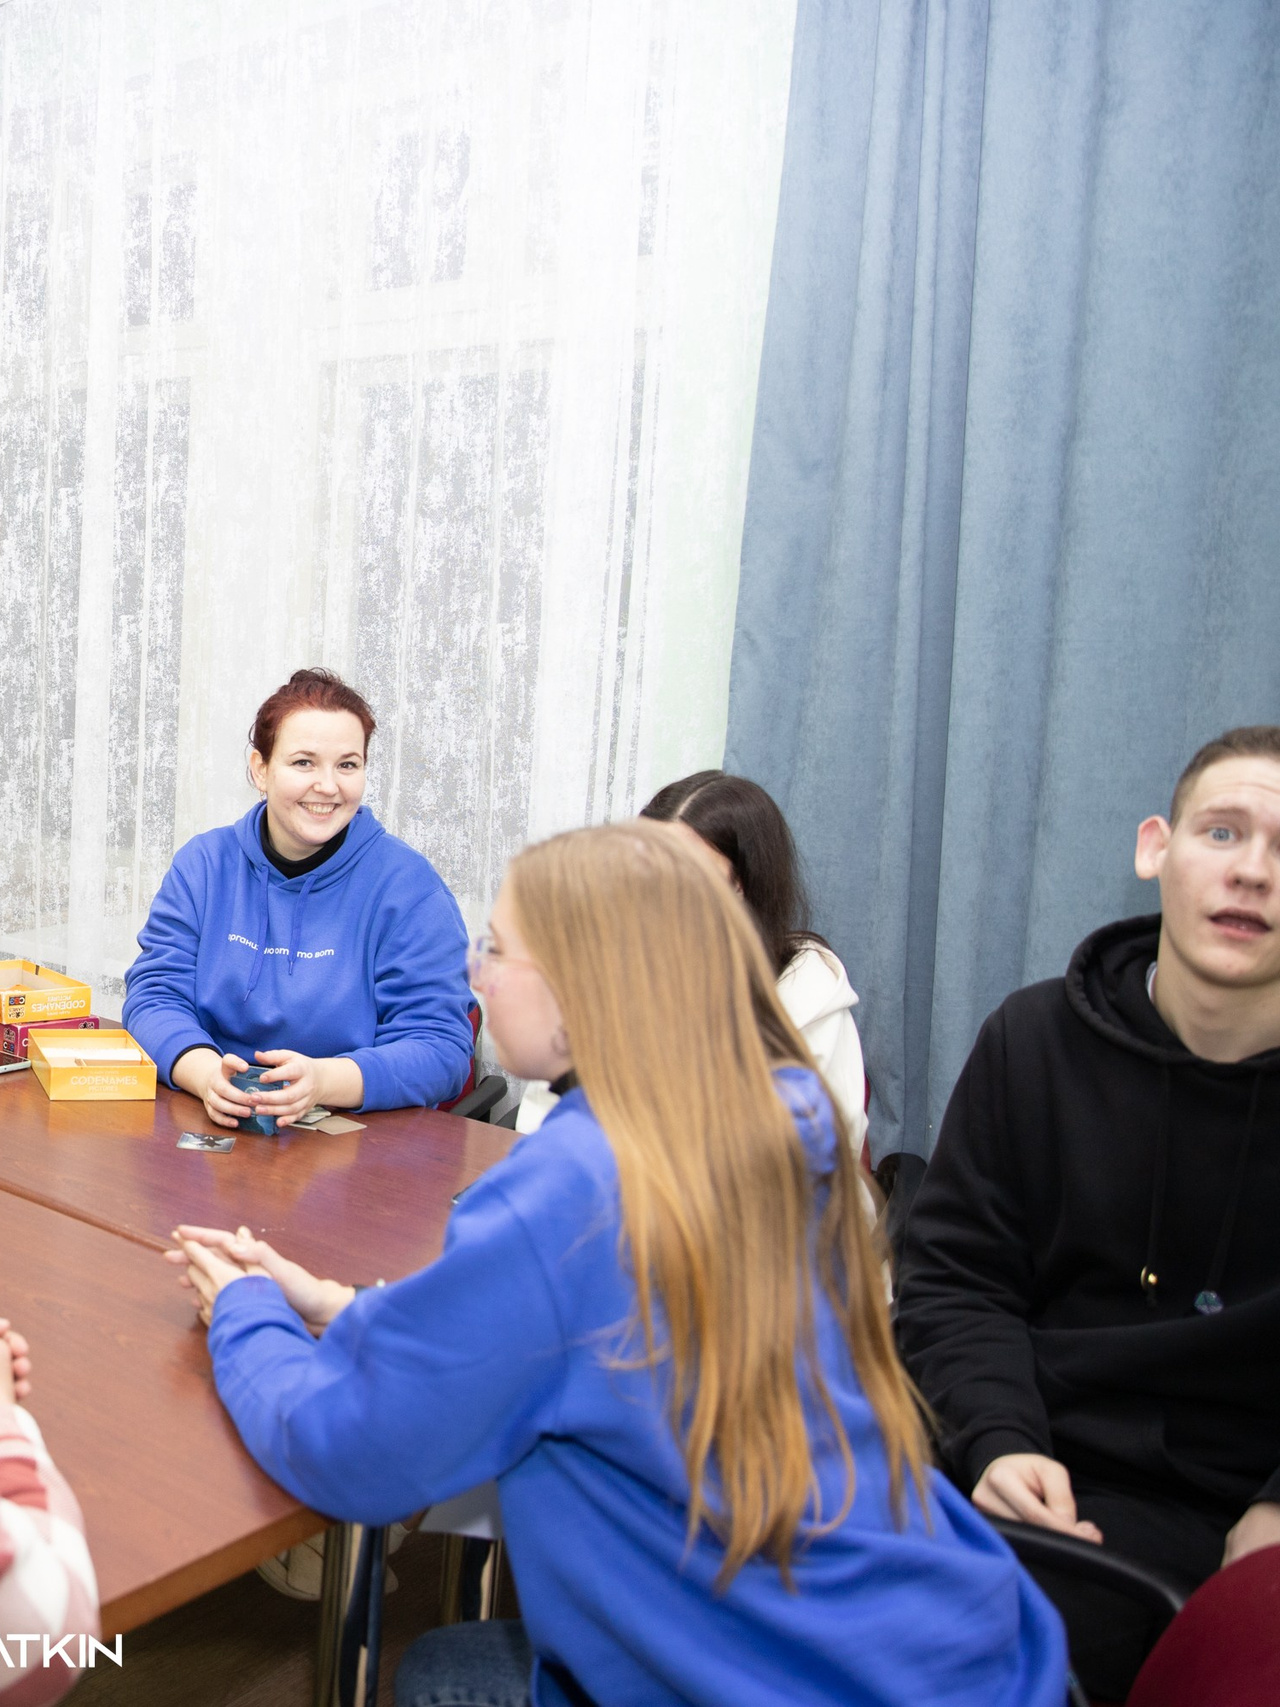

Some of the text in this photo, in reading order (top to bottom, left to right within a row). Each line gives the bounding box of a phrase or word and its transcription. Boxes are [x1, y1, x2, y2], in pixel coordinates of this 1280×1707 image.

[314, 948, 335, 959] вот
[31, 999, 86, 1013] CODENAMES
[71, 1075, 138, 1085] CODENAMES
